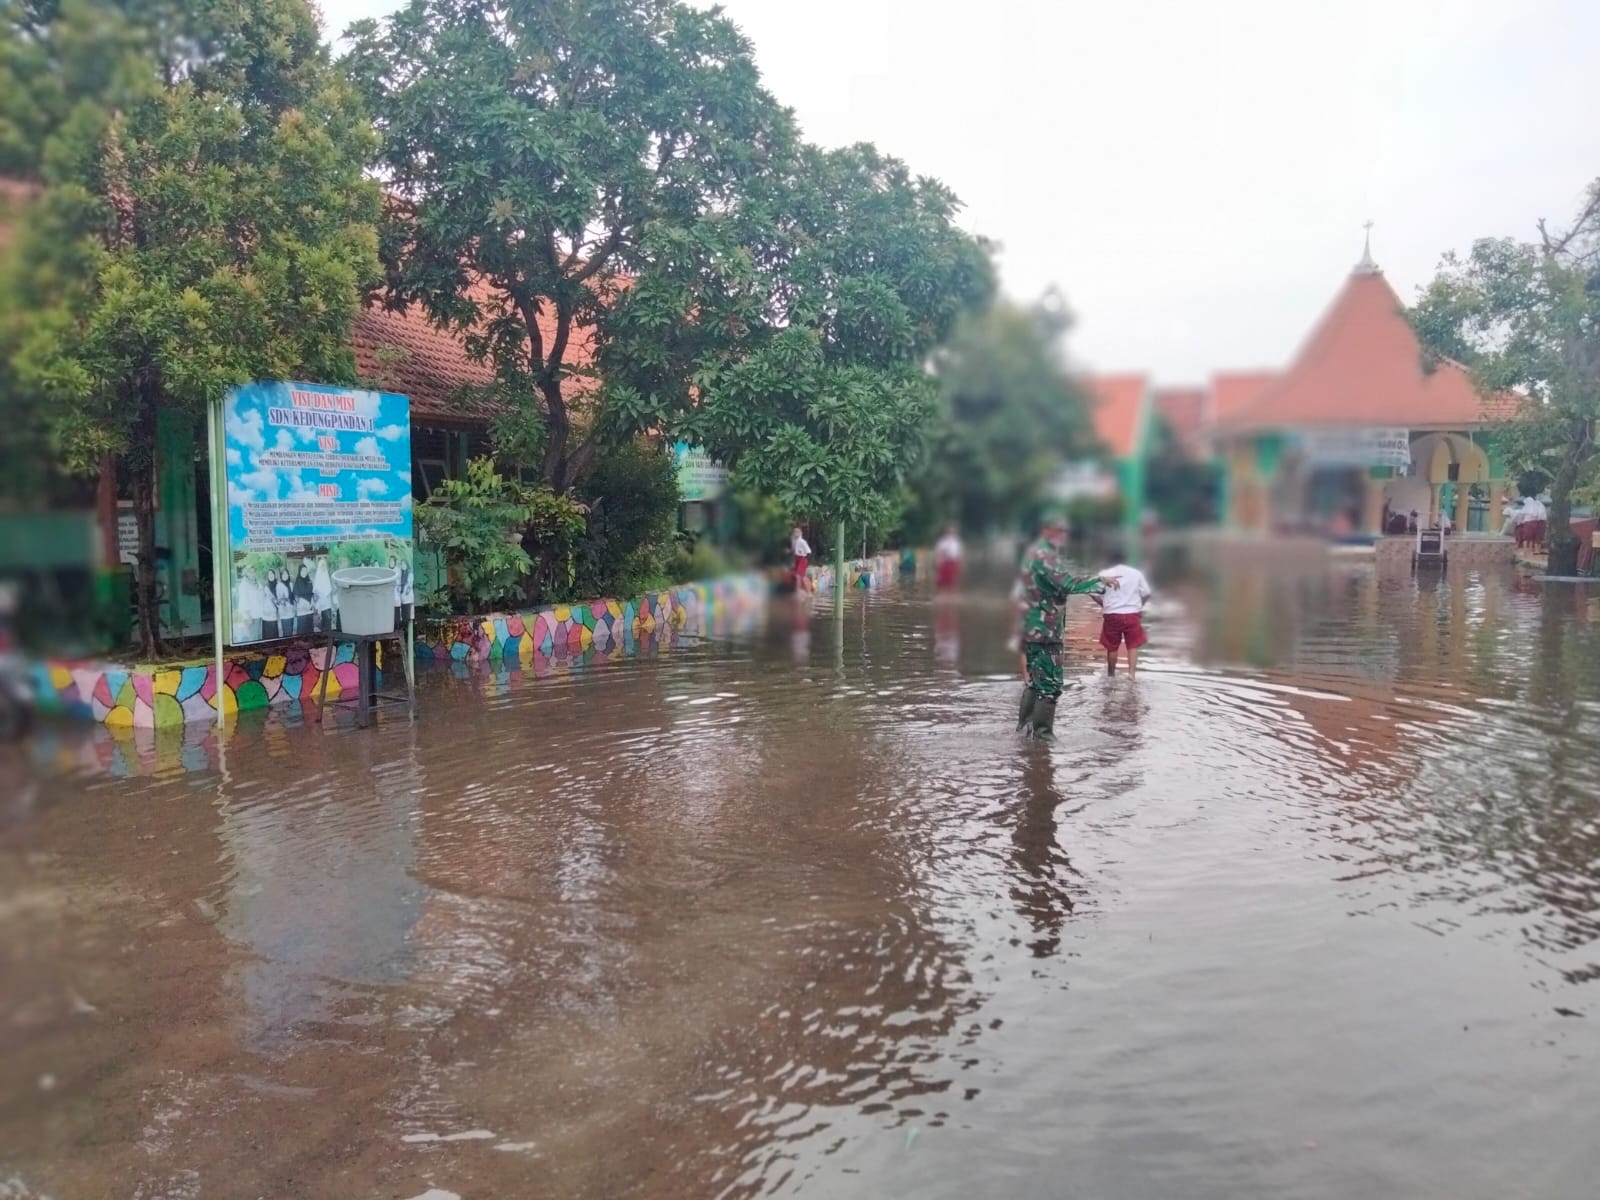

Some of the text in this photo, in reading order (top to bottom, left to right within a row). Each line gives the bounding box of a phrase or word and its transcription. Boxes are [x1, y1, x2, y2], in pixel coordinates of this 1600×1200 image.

[291, 391, 356, 411] VISI DAN MISI
[270, 408, 290, 425] SDN
[293, 411, 366, 431] KEDUNGPANDAN
[320, 484, 336, 497] MISI
